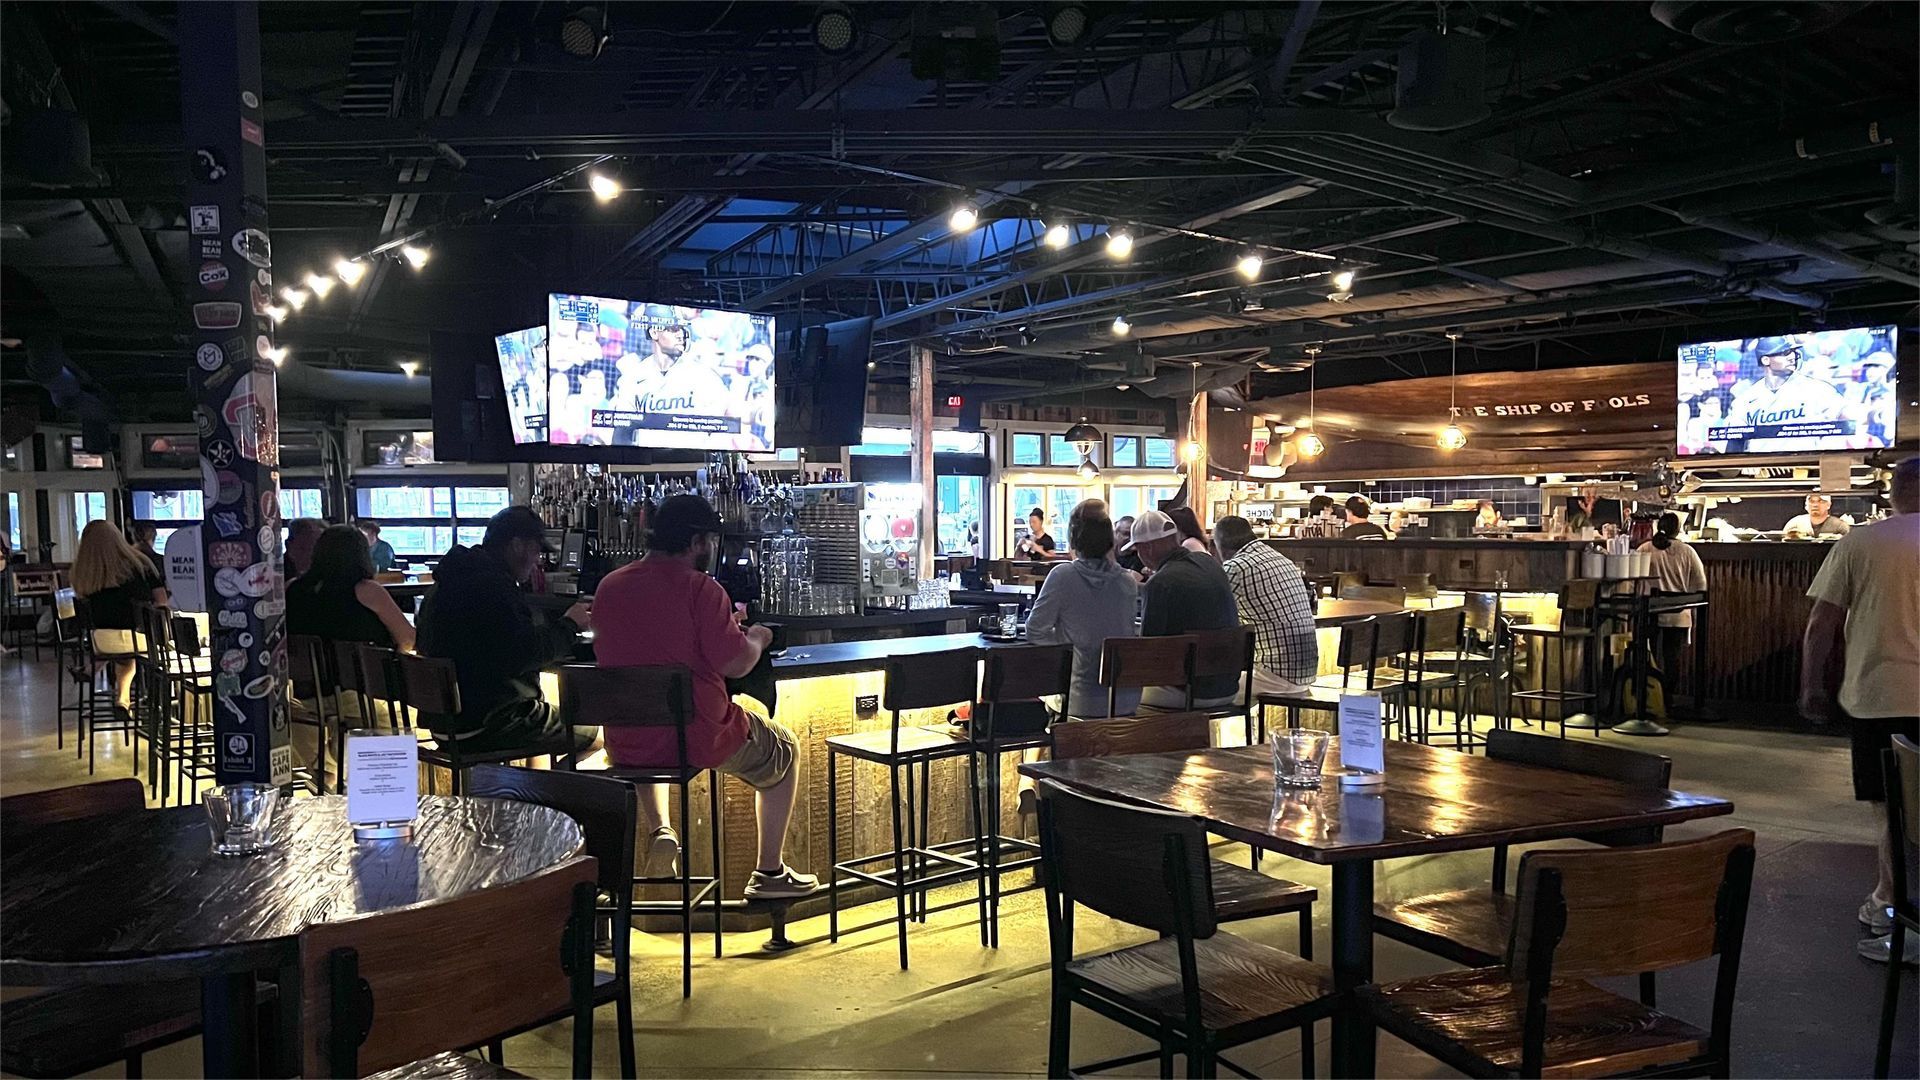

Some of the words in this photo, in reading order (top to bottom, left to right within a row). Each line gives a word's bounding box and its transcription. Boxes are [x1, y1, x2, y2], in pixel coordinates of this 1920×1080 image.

[634, 391, 695, 413] Miami
[1494, 404, 1542, 416] SHIP
[1550, 401, 1575, 413] OF
[1581, 394, 1651, 411] FOOLS
[1746, 403, 1806, 427] Miami
[172, 556, 195, 564] MEAN
[172, 566, 195, 574] BEAN
[272, 754, 289, 767] CAPE
[273, 763, 290, 778] ANN
